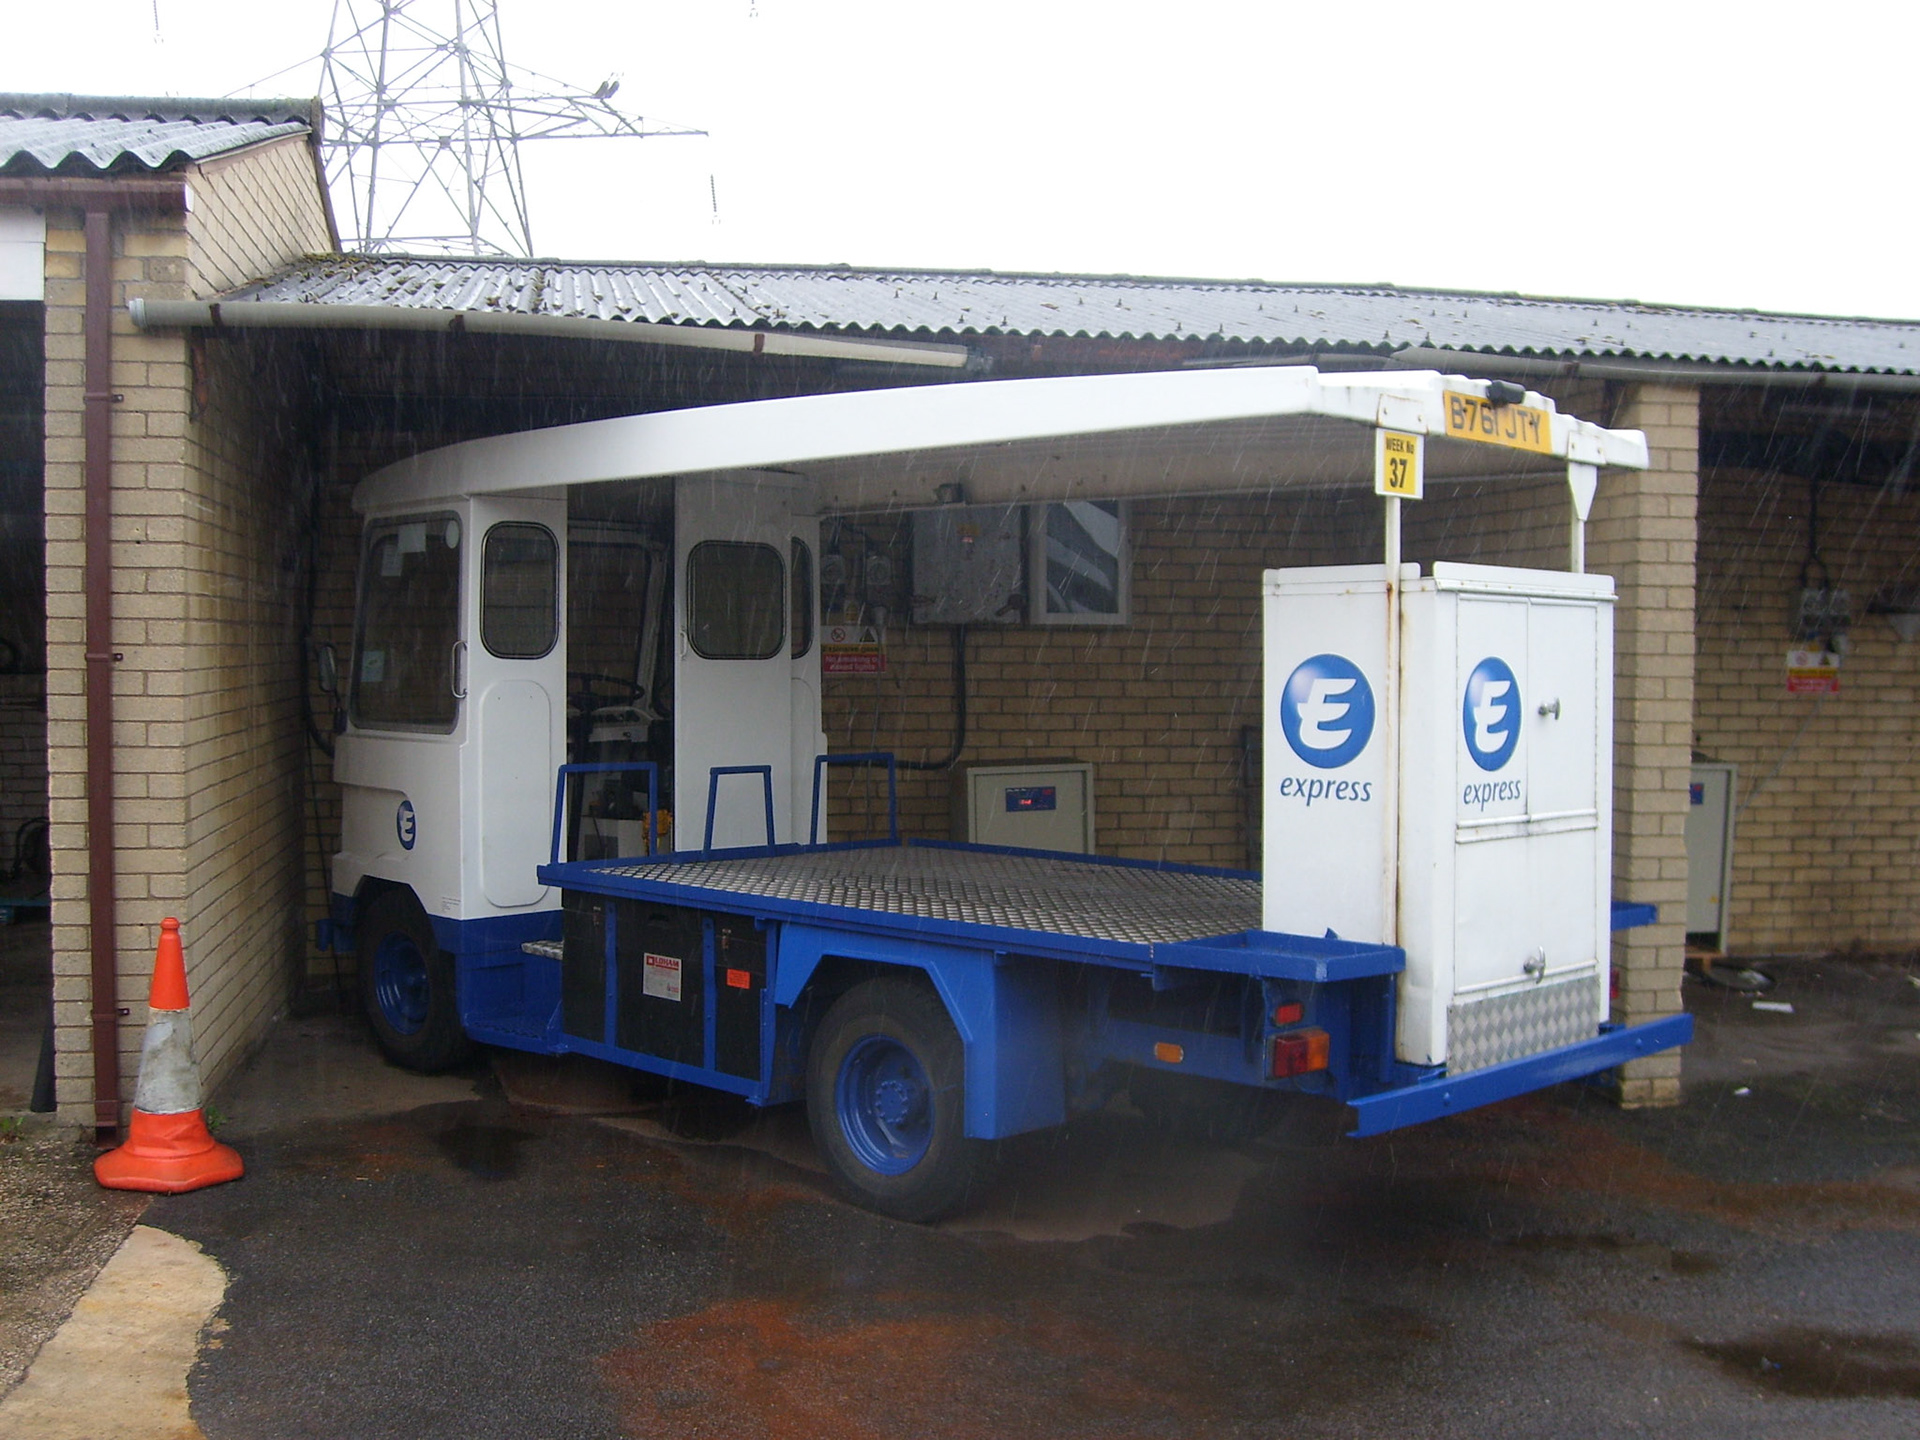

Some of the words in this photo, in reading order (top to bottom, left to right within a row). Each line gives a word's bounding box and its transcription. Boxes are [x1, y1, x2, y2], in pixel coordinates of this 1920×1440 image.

[1451, 396, 1499, 436] B761
[1505, 407, 1541, 444] JTY
[1386, 437, 1404, 452] WEEK
[1389, 457, 1407, 489] 37
[1280, 776, 1372, 807] express
[1463, 779, 1521, 812] express
